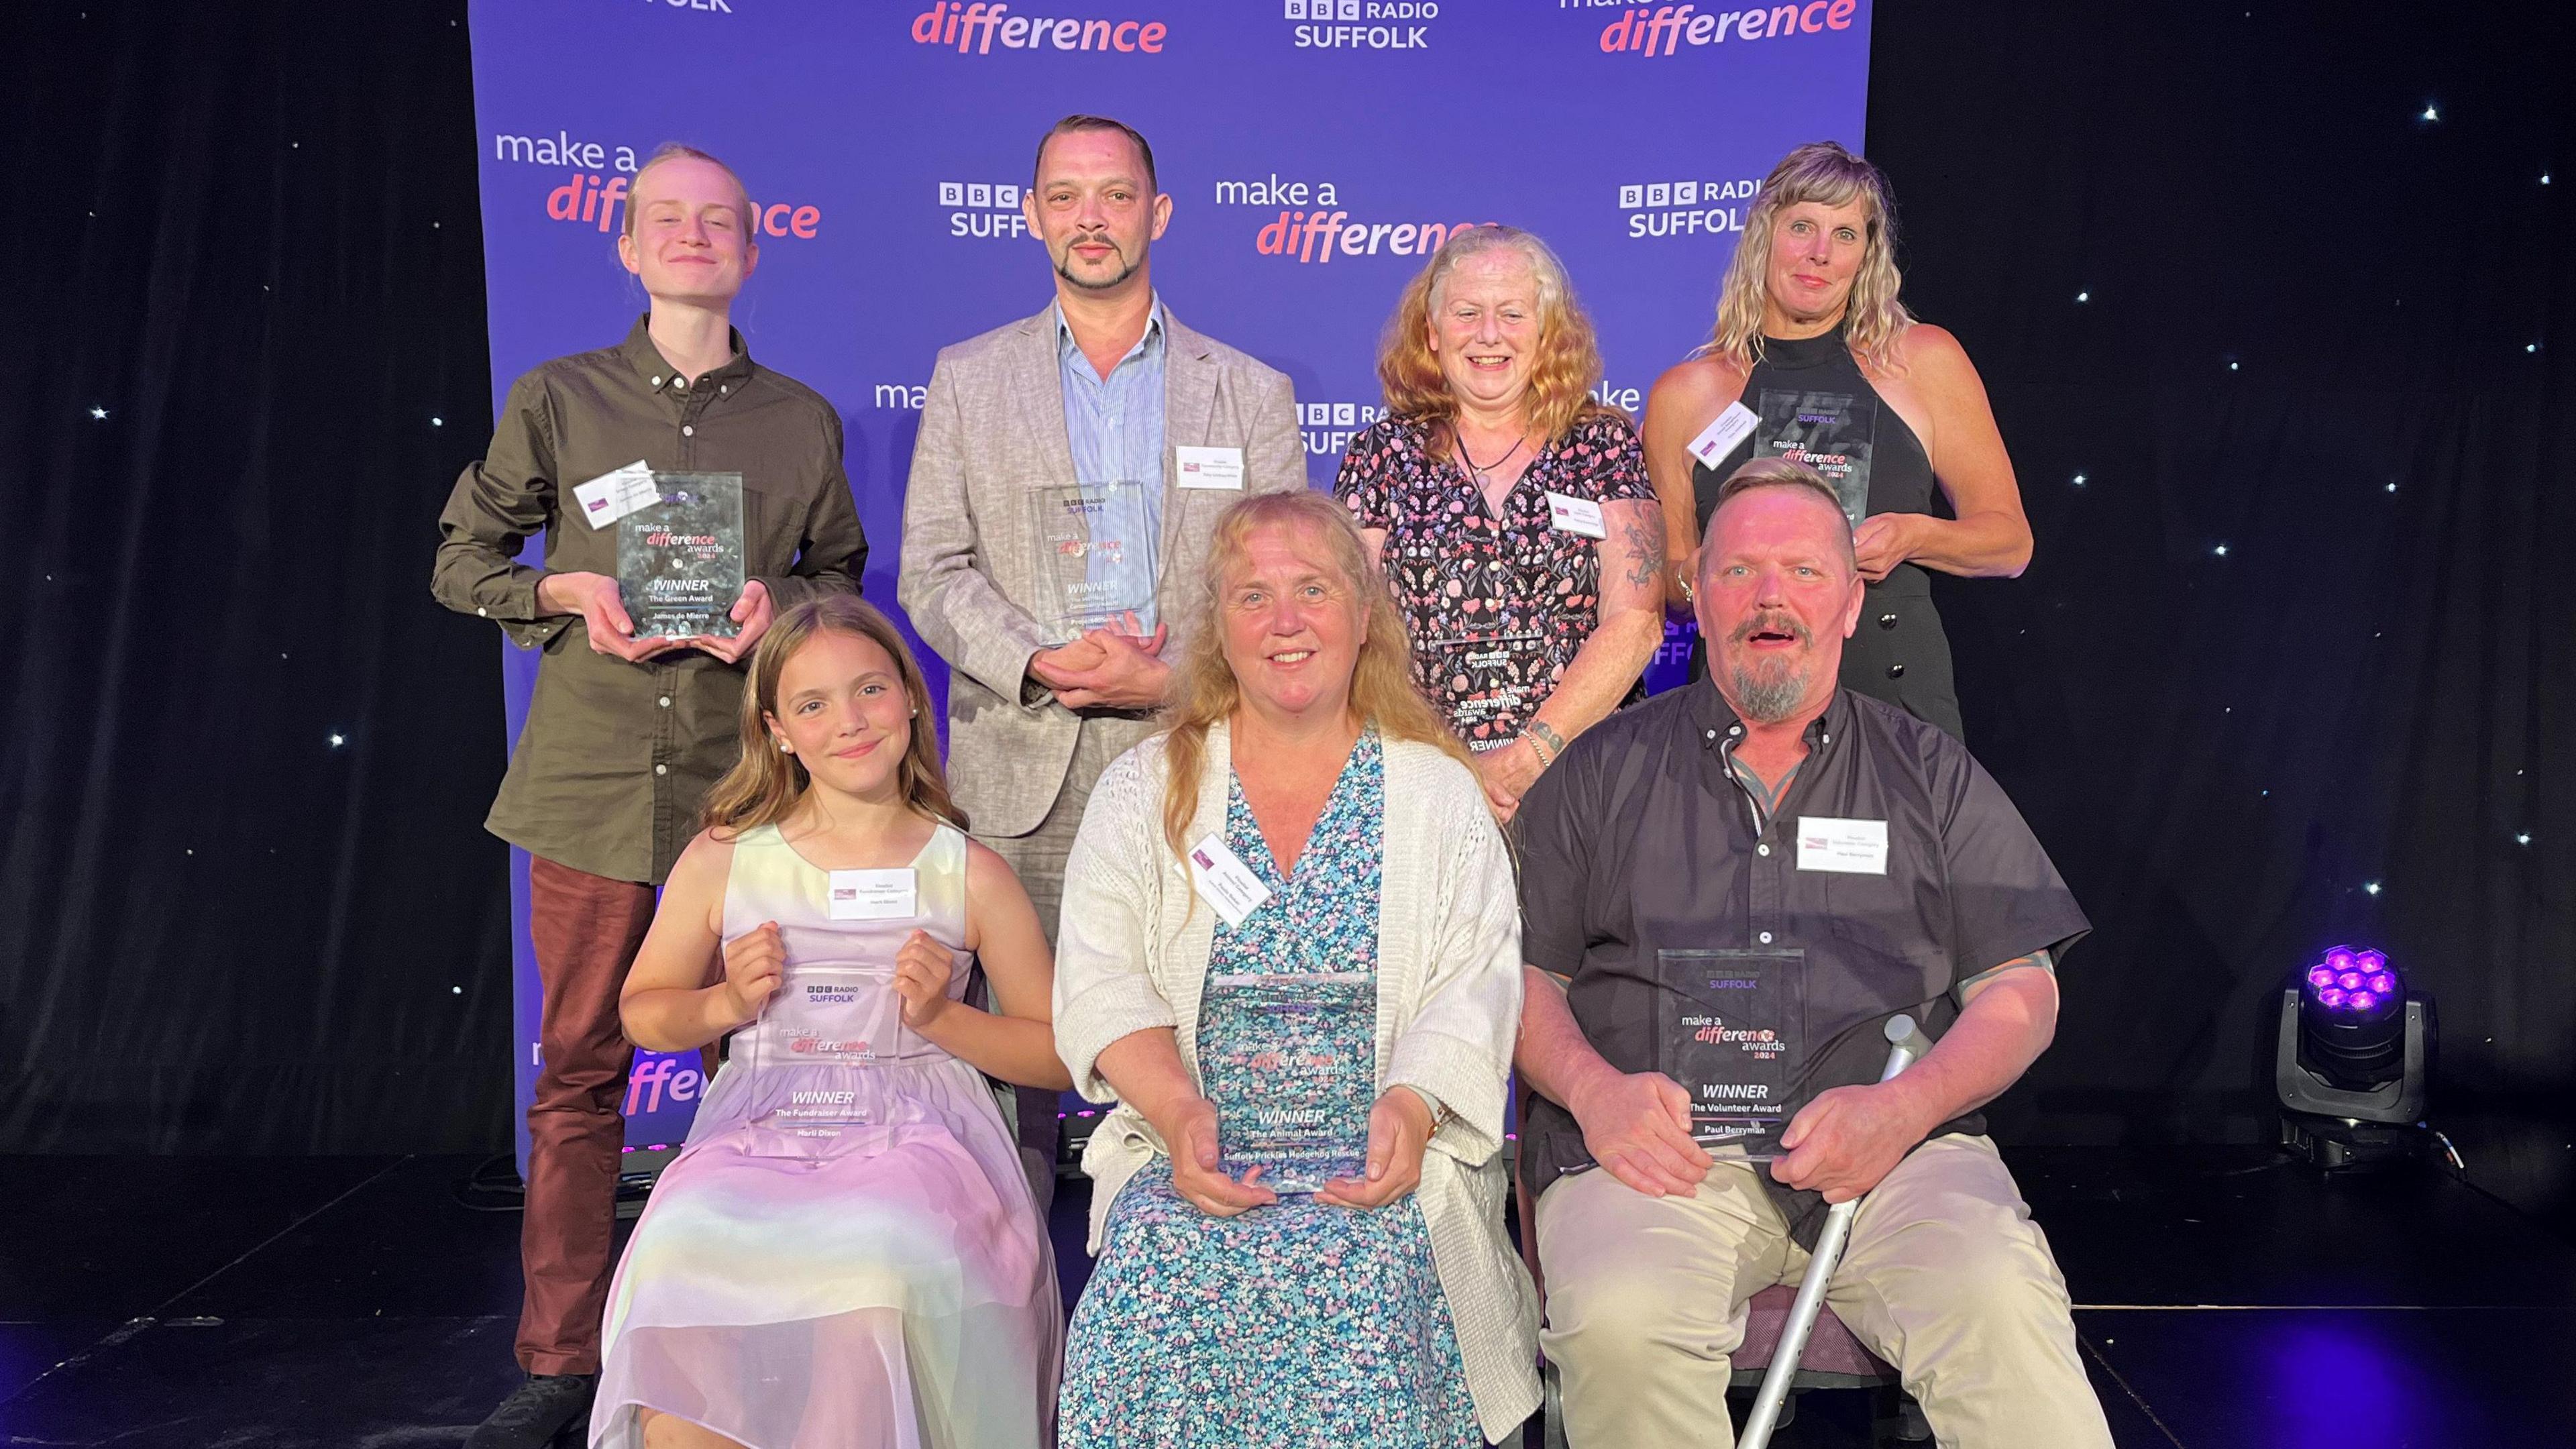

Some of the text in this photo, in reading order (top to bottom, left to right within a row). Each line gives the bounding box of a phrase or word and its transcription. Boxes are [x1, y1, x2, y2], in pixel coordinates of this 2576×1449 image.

[1287, 1, 1439, 19] BBC RADIO
[912, 1, 1167, 54] difference
[1600, 0, 1856, 57] difference
[1295, 25, 1428, 48] SUFFOLK
[496, 131, 638, 172] make a
[943, 185, 1015, 205] BBC
[1216, 173, 1338, 205] make a
[1623, 179, 1761, 206] BBC RADI
[951, 212, 1026, 237] SUFF
[1629, 207, 1745, 237] SUFFOL
[1256, 211, 1498, 263] differen
[875, 384, 928, 409] ma
[1799, 415, 1836, 424] SUFFOLK
[1773, 440, 1798, 449] make
[1782, 449, 1845, 464] difference
[1818, 463, 1852, 472] awards
[635, 523, 661, 532] make
[647, 533, 715, 547] difference
[1047, 533, 1071, 542] make
[687, 543, 724, 553] awards
[653, 579, 709, 591] WINNER
[1068, 581, 1117, 594] WINNER
[1709, 980, 1756, 989] SUFFOLK
[810, 994, 854, 1002] SUFFOLK
[1682, 1014, 1721, 1026] make a
[780, 1026, 818, 1036] make a
[1695, 1026, 1775, 1044] difference
[1742, 1040, 1785, 1051] awards
[835, 1050, 875, 1060] awards
[1300, 1062, 1345, 1075] awards
[792, 1091, 855, 1104] WINNER
[1703, 1084, 1768, 1099] WINNER
[775, 1109, 867, 1117] The Fundraiser Award
[1690, 1103, 1782, 1112] The Volunteer Award
[1258, 1110, 1326, 1124] WINNER
[1269, 1130, 1301, 1138] Animal
[1303, 1129, 1333, 1137] Award
[1725, 1126, 1766, 1135] Berryman
[1289, 1150, 1330, 1159] Hedgehog
